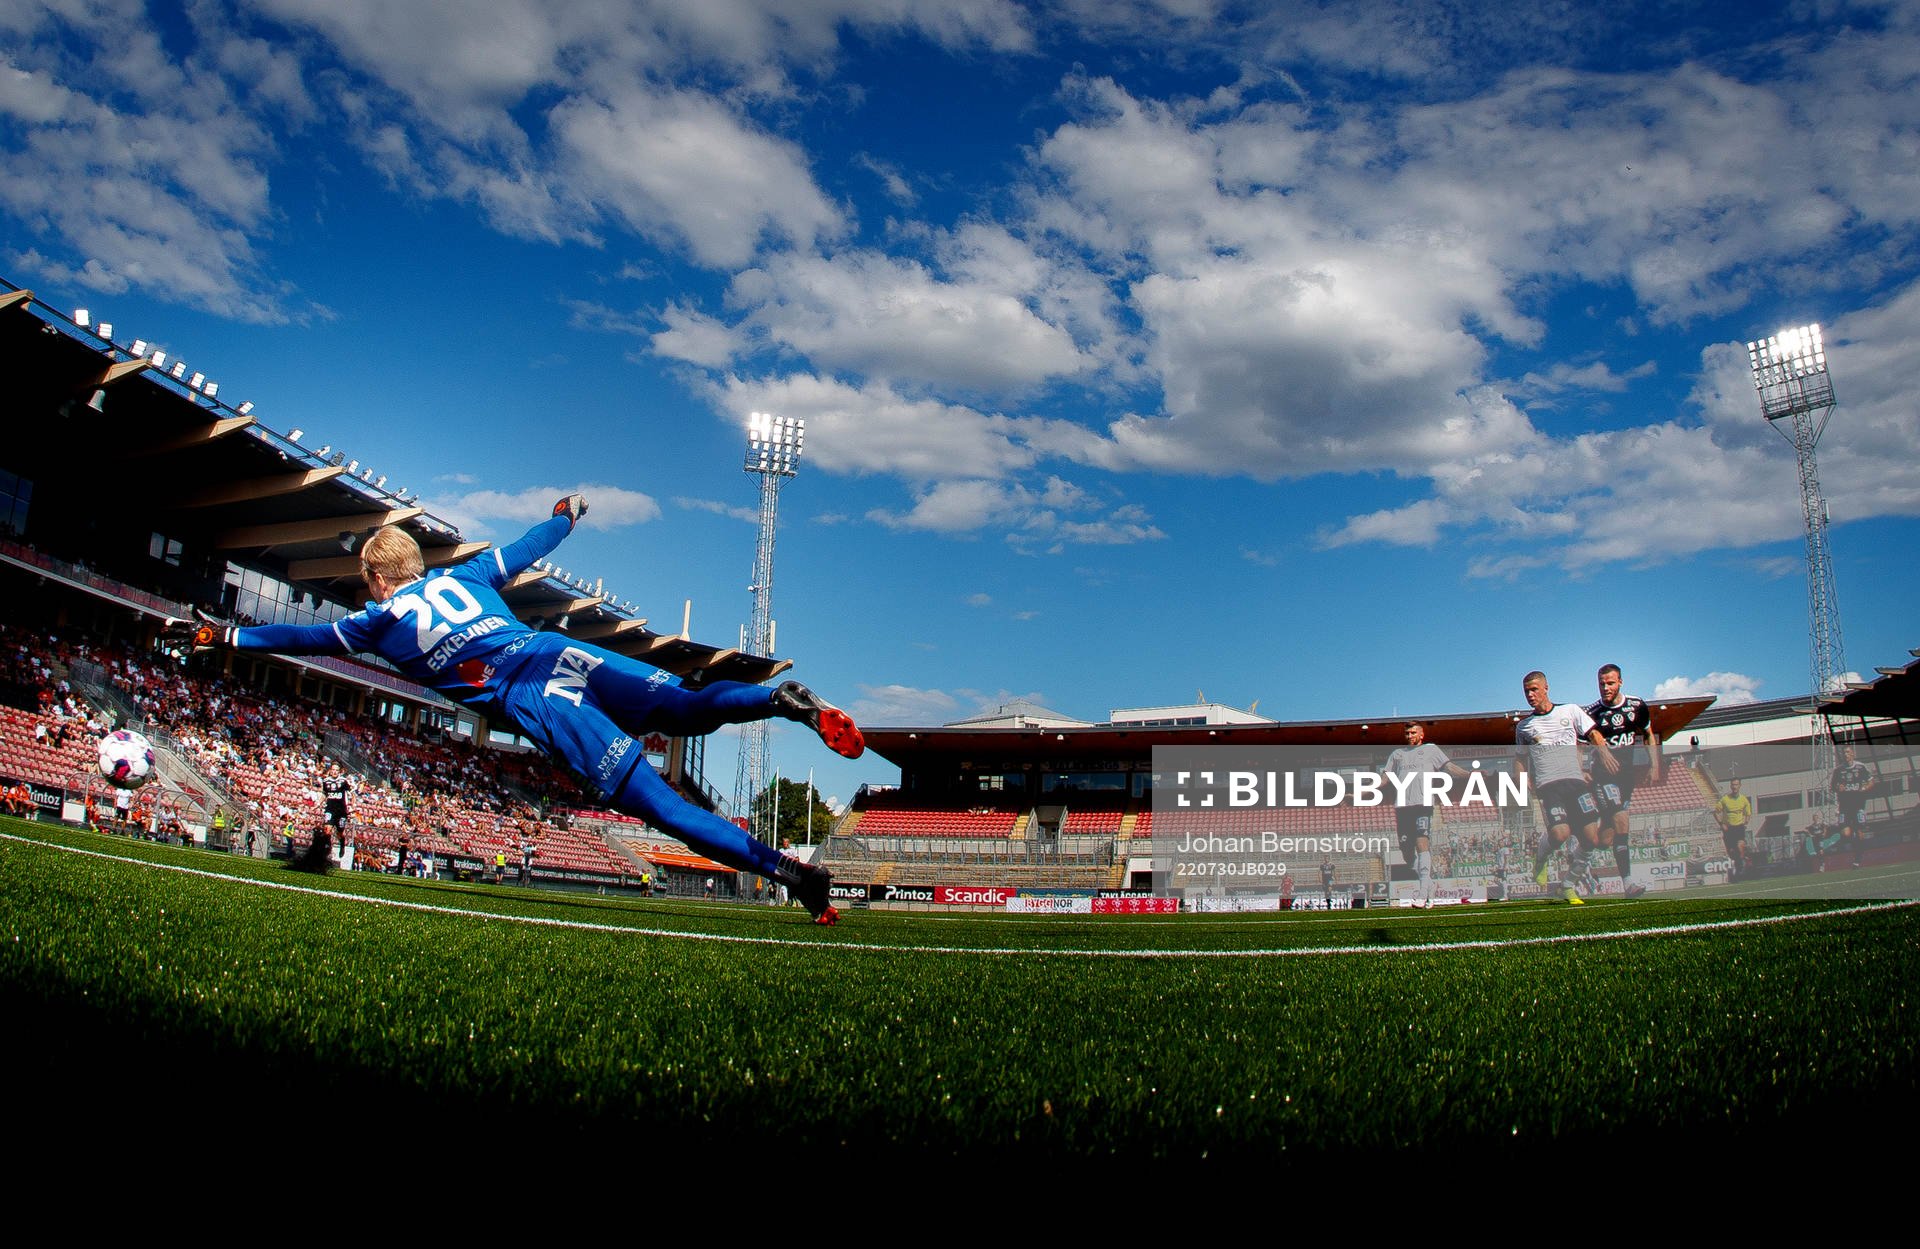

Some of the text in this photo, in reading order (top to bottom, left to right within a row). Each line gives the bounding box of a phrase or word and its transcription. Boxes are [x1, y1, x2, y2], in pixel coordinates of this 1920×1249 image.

[389, 575, 483, 654] 20
[426, 616, 510, 673] ESKELINEN
[829, 886, 866, 898] am.se
[885, 885, 933, 901] Printoz
[944, 888, 1006, 904] Scandic
